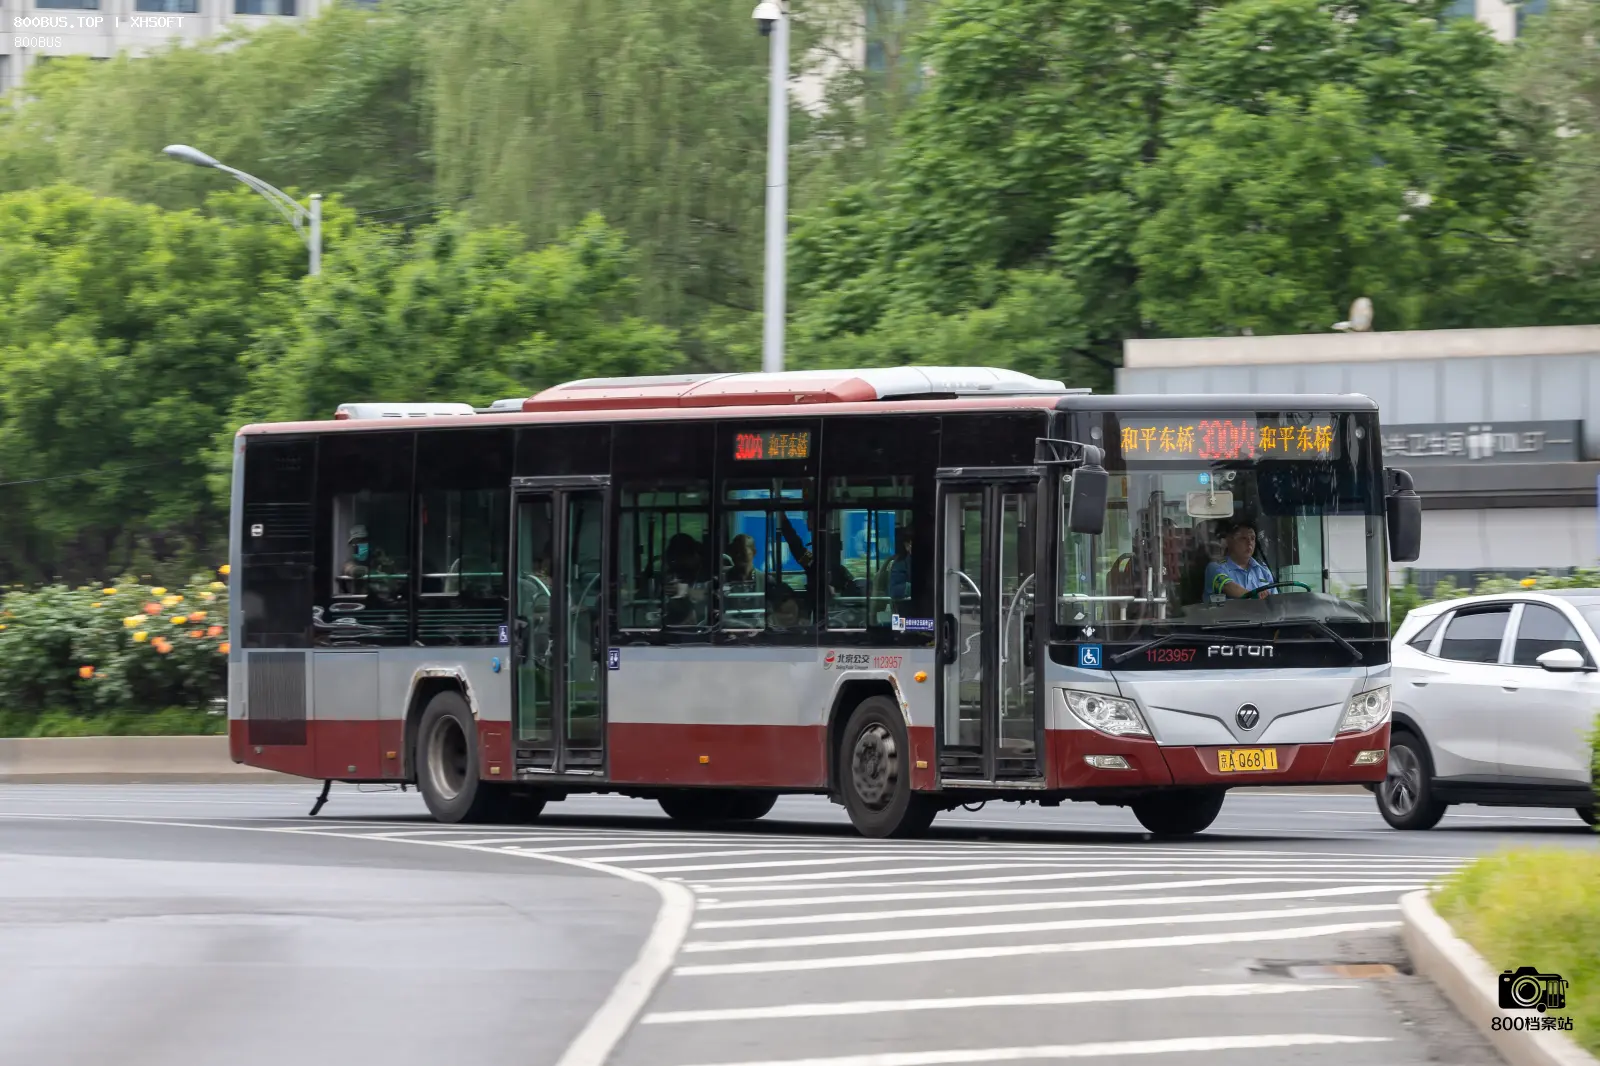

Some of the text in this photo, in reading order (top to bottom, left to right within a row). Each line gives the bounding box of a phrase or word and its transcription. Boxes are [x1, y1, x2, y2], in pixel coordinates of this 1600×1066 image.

[767, 432, 808, 458] 和平东桥
[1120, 426, 1195, 453] 和平东桥
[1258, 425, 1333, 452] 和平东桥
[836, 653, 870, 664] 北京公交
[873, 656, 903, 669] 1123957
[1146, 644, 1274, 662] 1123957 FOTON
